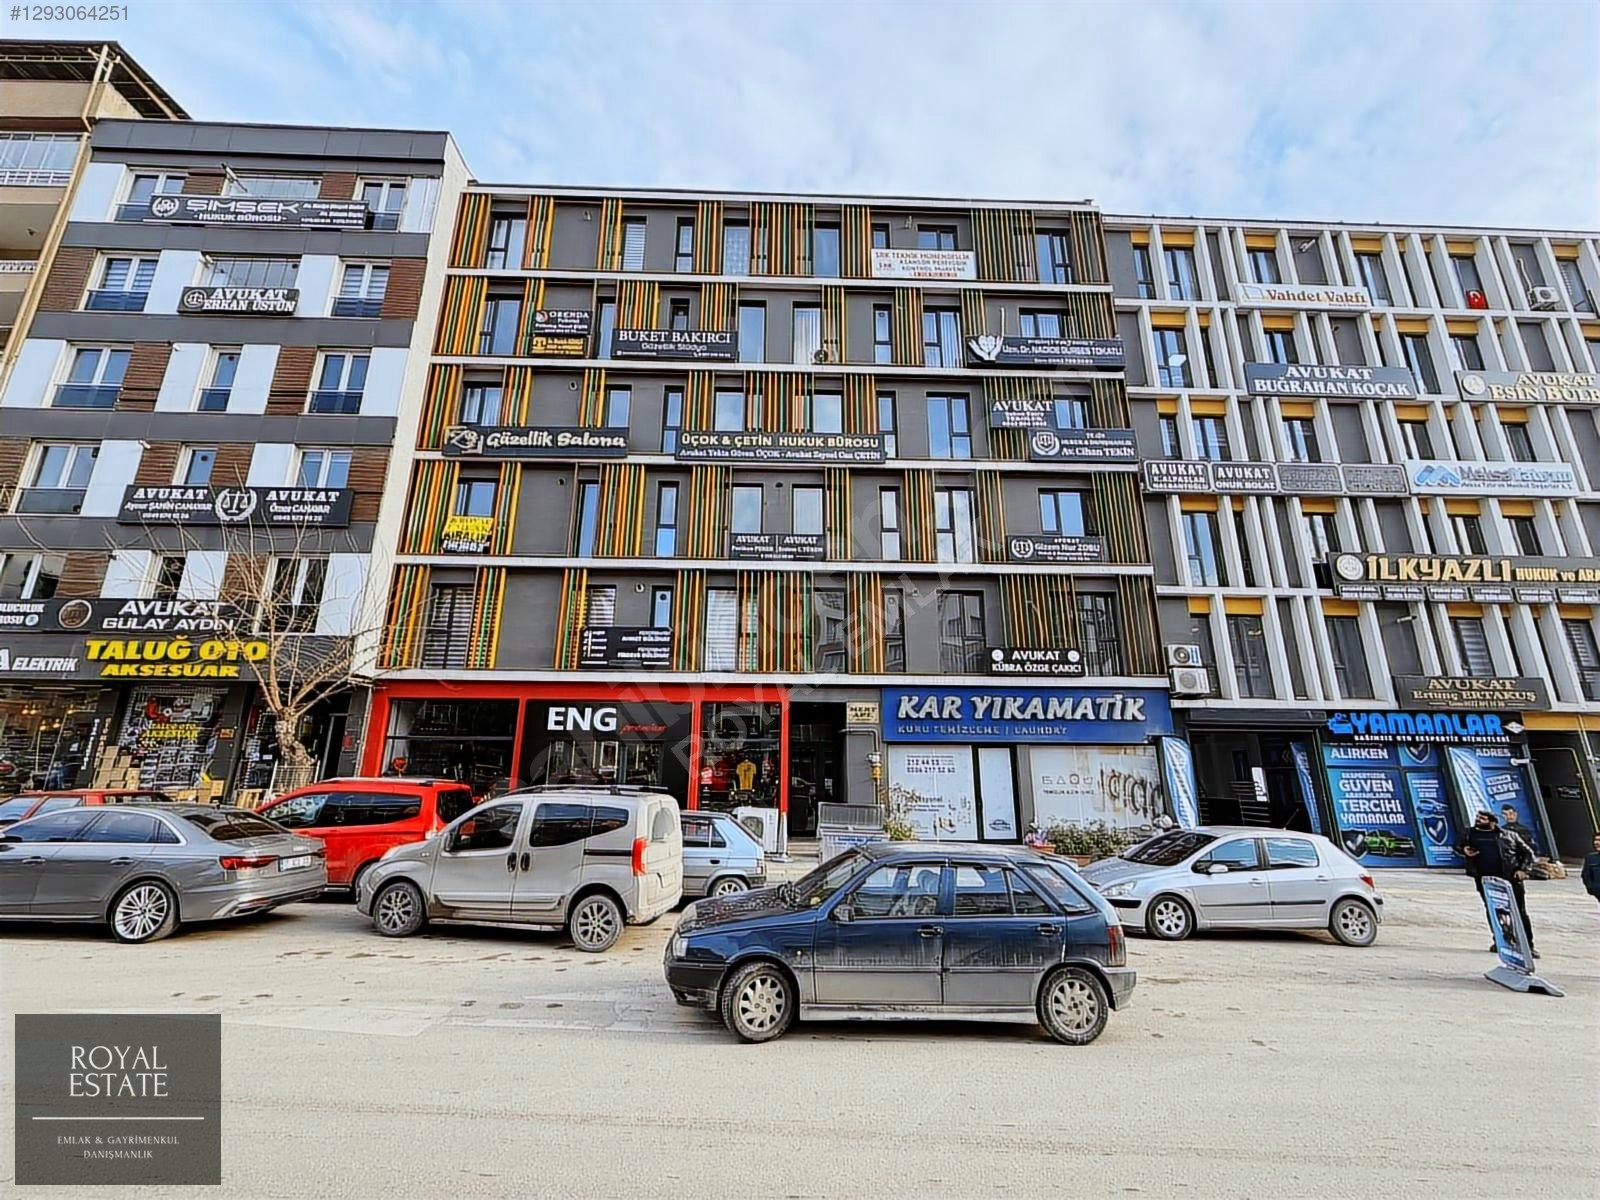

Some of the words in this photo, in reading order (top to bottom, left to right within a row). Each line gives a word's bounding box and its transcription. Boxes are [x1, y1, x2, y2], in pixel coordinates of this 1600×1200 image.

[211, 288, 288, 301] AVUKAT
[1266, 289, 1322, 302] Vahdet
[202, 299, 248, 310] ERKAN
[619, 330, 669, 342] BUKET
[672, 331, 731, 343] BAKIRCI
[1286, 367, 1373, 380] AVUKAT
[1517, 374, 1596, 387] AVUKAT
[1254, 377, 1349, 395] BUĞRAHAN
[1349, 383, 1411, 398] KOÇAK
[992, 400, 1053, 411] AVUKAT
[486, 431, 553, 448] Güzellik
[557, 432, 627, 448] Salonu
[681, 433, 718, 447] ÜÇOK
[721, 435, 731, 445] &
[734, 434, 772, 448] ÇETİN
[779, 436, 824, 447] HUKUK
[828, 436, 879, 448] BÜROSU
[1151, 463, 1204, 475] AVUKAT
[1217, 467, 1270, 479] AVUKAT
[133, 487, 208, 500] AVUKAT
[266, 490, 340, 502] AVUKAT
[736, 535, 770, 543] AVUKAT
[784, 536, 818, 544] AVUKAT
[1515, 567, 1558, 582] HUKUK
[1560, 571, 1575, 582] ve
[119, 600, 227, 616] AVUKAT
[102, 616, 168, 630] GÜLAY
[85, 634, 192, 661] TALUĞ
[200, 640, 268, 662] OTO
[1012, 650, 1060, 660] AVUKAT
[100, 664, 240, 678] AKSESUAR
[1428, 679, 1516, 690] AVUKAT
[898, 694, 962, 721] KAR
[971, 693, 1147, 722] YIKAMATİK
[547, 706, 618, 732] ENG
[1350, 713, 1504, 735] YAMANLAR
[898, 725, 929, 733] KURU
[1331, 748, 1389, 760] ALIRKEN
[1340, 812, 1406, 824] YAMANLAR
